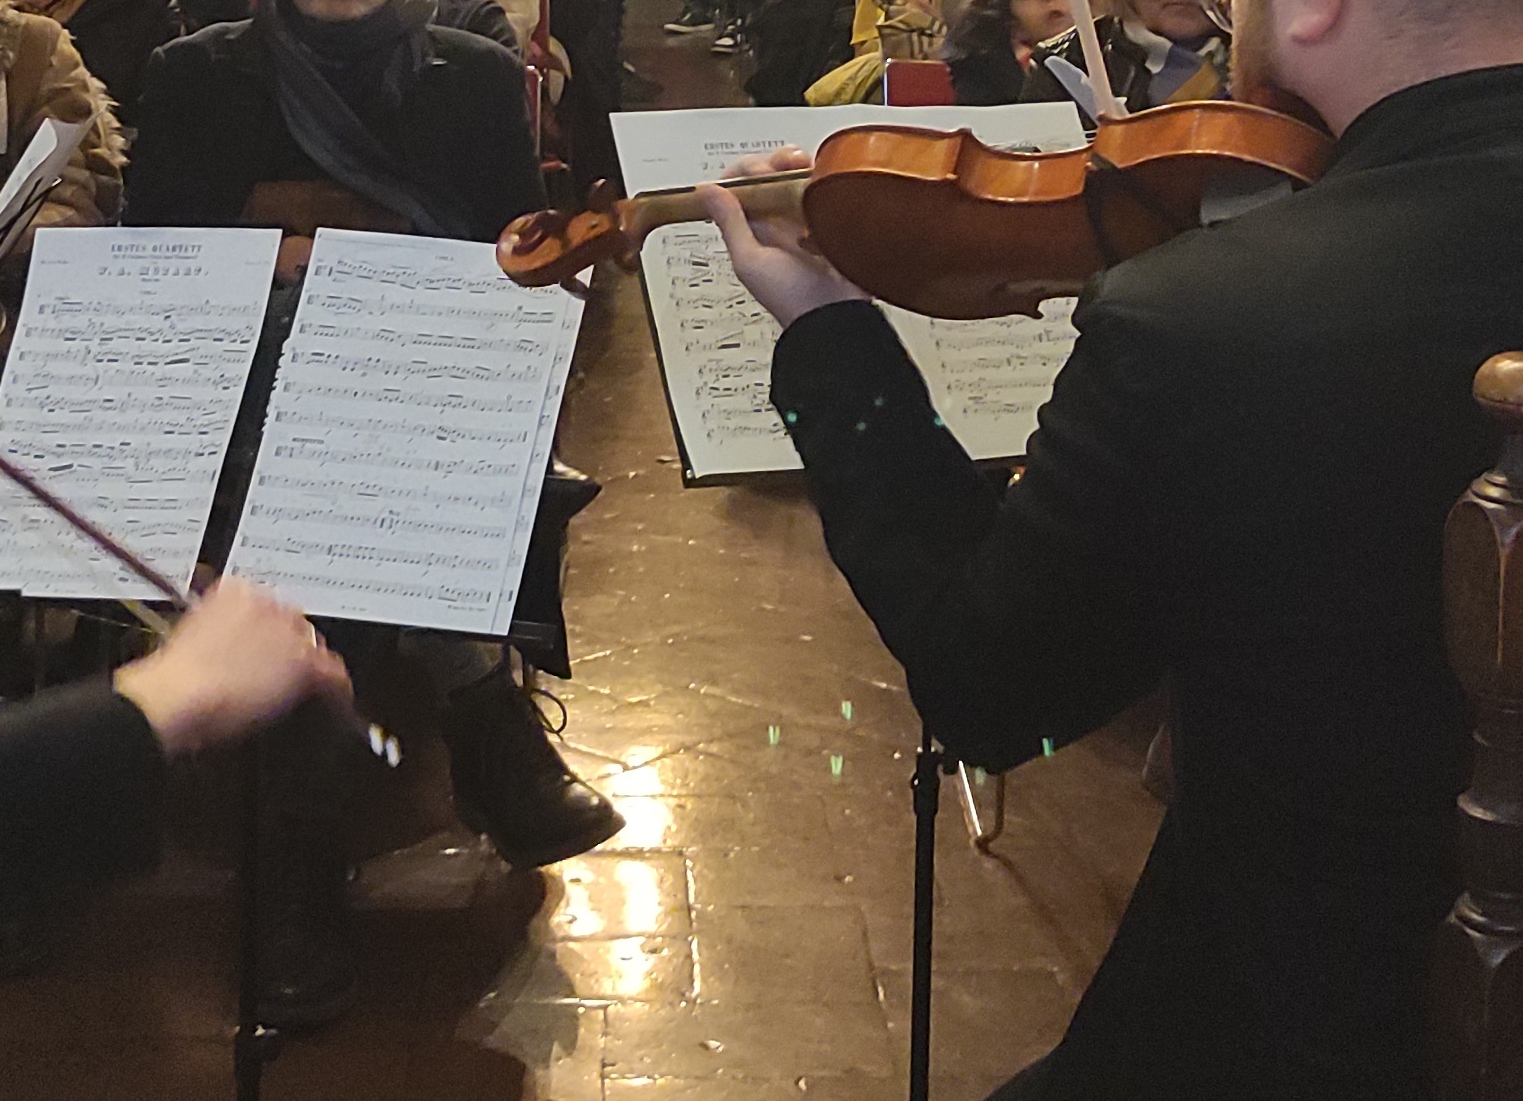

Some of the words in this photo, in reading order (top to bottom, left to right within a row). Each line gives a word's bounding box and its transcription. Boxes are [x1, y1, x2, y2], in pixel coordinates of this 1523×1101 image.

[704, 142, 735, 151] ERSTES
[739, 139, 785, 149] QUARTETT
[110, 243, 147, 253] ERSTES
[151, 243, 203, 253] QUARTETT
